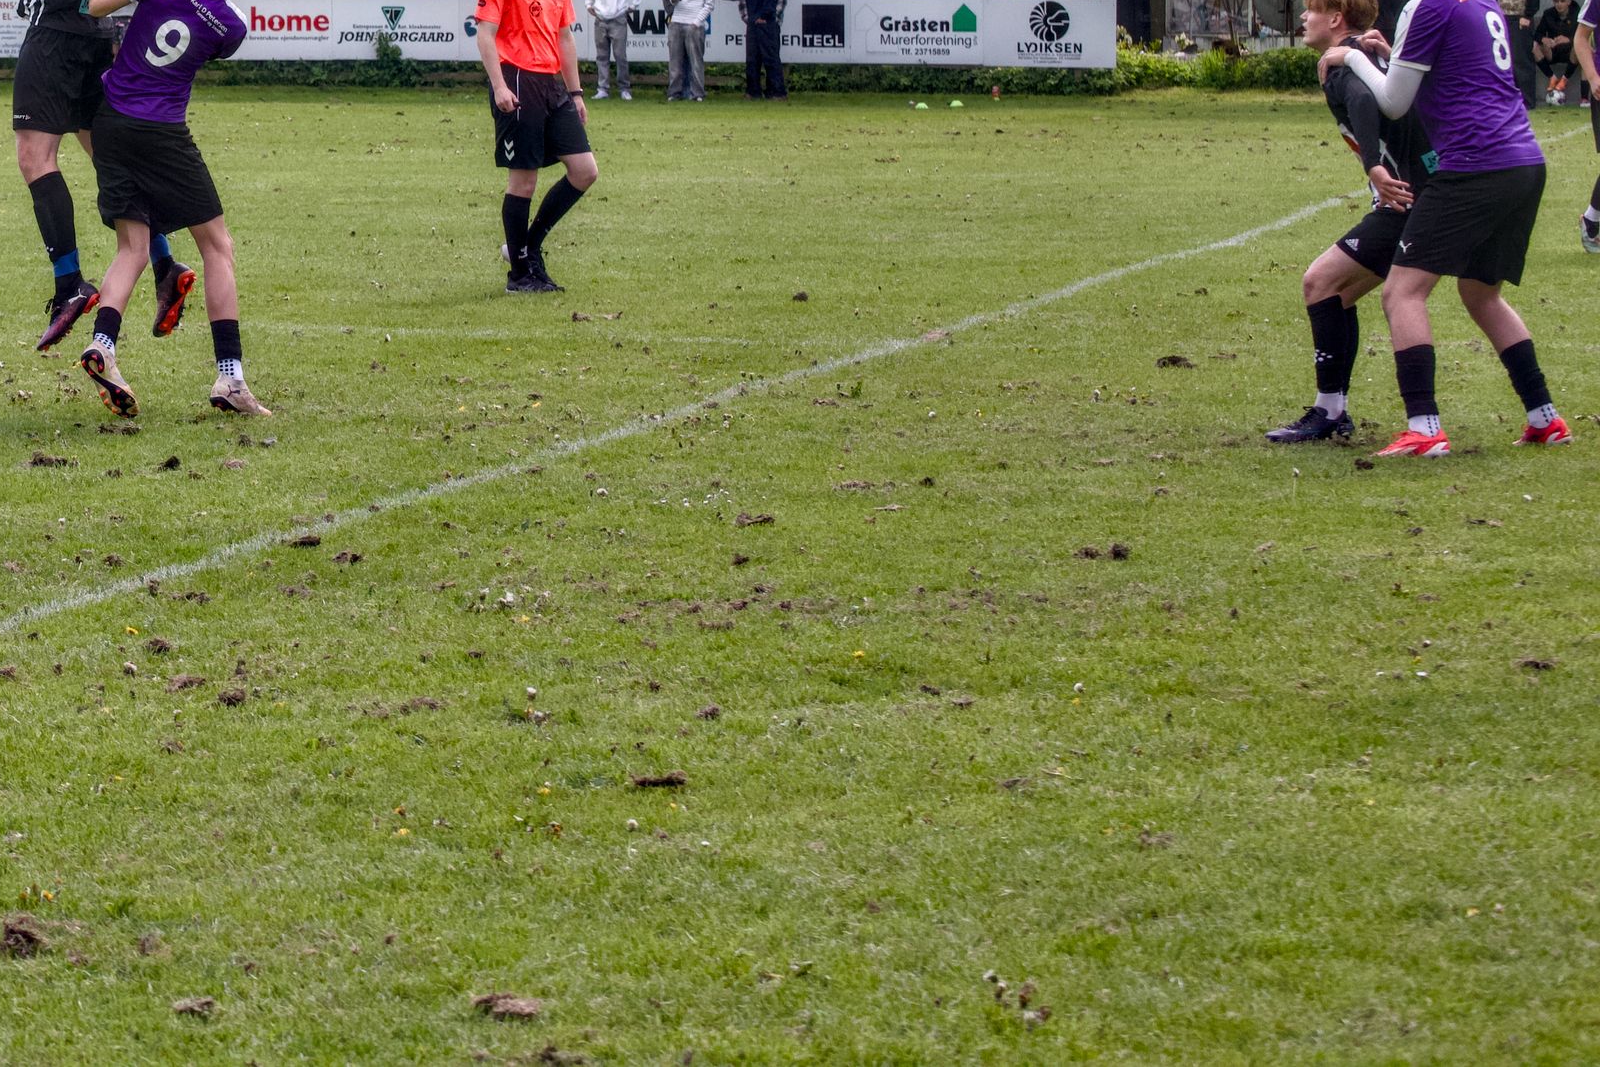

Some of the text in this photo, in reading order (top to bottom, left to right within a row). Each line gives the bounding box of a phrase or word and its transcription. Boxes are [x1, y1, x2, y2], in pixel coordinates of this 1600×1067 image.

[205, 11, 228, 33] Petersen
[250, 6, 330, 32] home
[880, 16, 950, 32] Gråsten
[144, 19, 191, 68] 9
[337, 32, 375, 44] JOHN
[803, 34, 843, 47] TEGL
[880, 34, 972, 49] Murerforretning
[1485, 11, 1512, 71] 8
